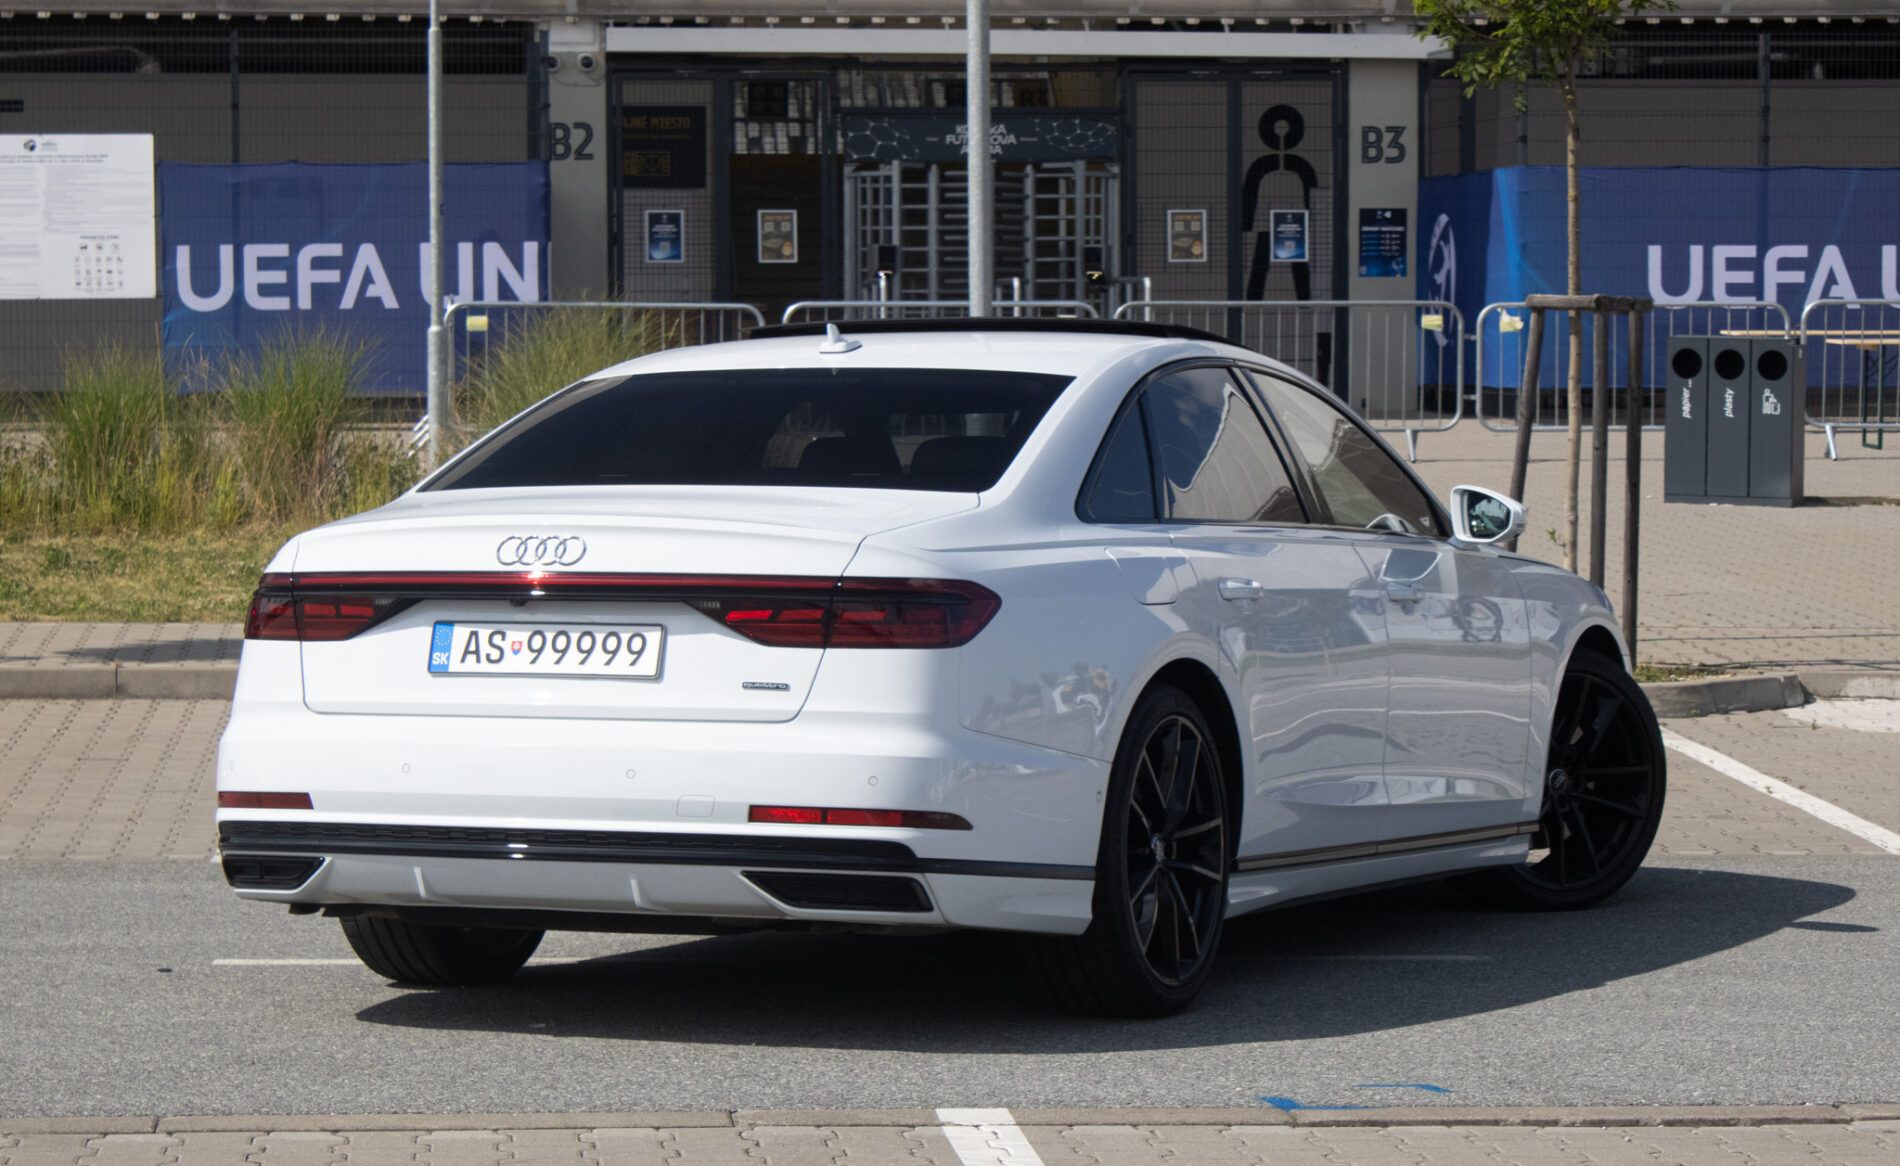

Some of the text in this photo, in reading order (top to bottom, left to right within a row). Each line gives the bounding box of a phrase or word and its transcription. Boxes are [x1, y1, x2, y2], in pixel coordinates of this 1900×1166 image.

[550, 122, 595, 161] B2
[1361, 126, 1407, 164] B3
[175, 243, 400, 312] UEFA
[1648, 244, 1861, 309] UEFA
[1681, 387, 1692, 419] papier
[1723, 388, 1735, 418] plasty
[432, 652, 449, 665] SK
[460, 629, 647, 667] AS 99999
